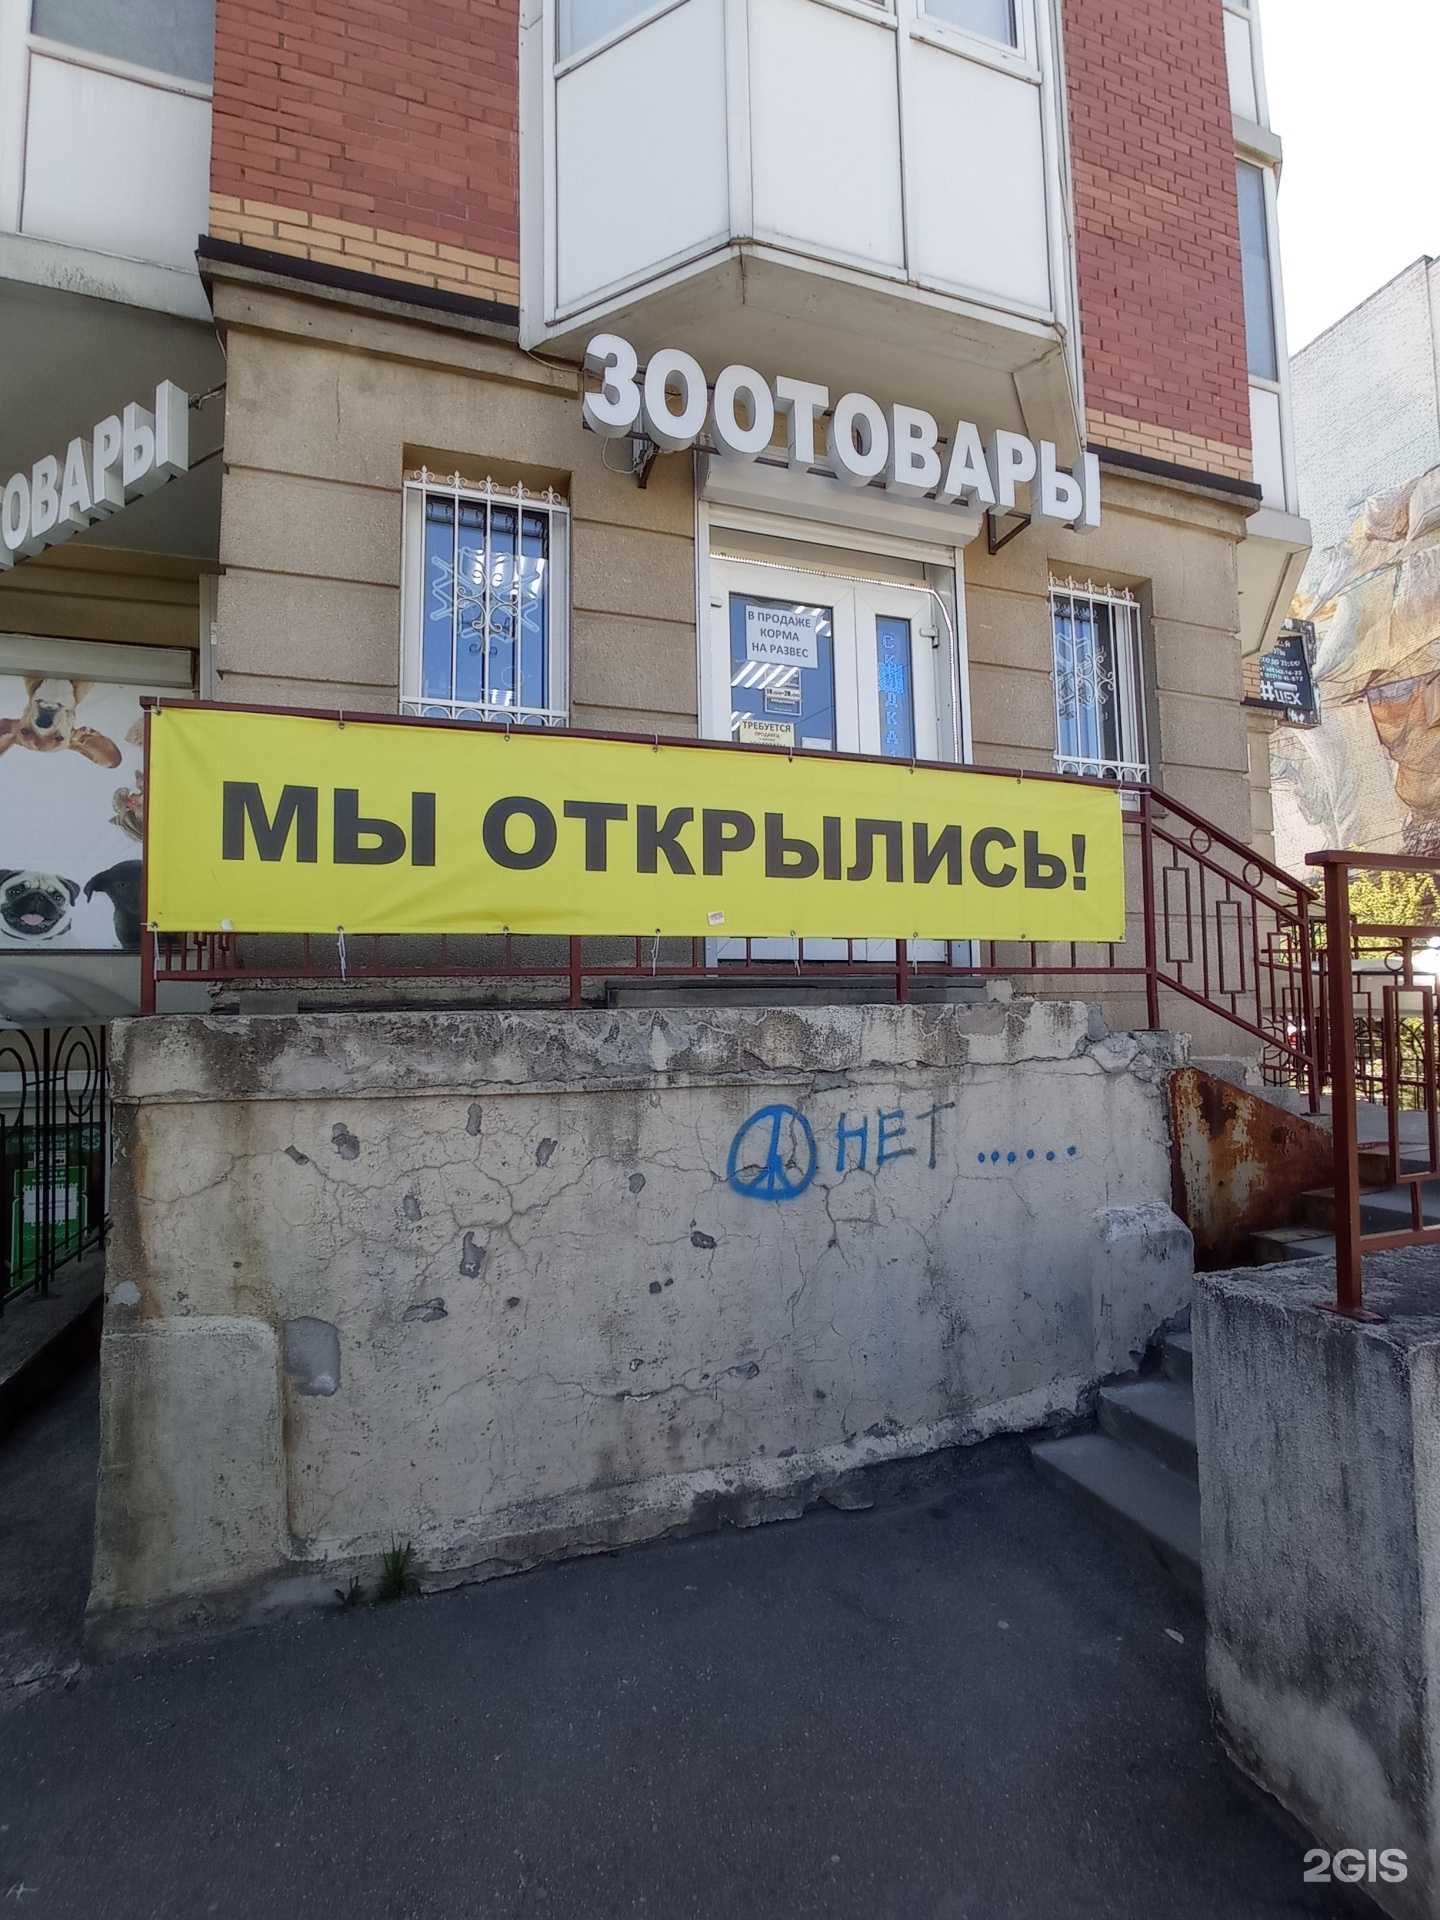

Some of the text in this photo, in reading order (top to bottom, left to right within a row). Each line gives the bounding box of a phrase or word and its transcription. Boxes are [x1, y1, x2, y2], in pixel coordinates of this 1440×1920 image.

[584, 333, 1100, 532] ЗООТОВАРЫ
[0, 379, 188, 560] ОВАРЫ
[748, 610, 811, 628] В ПРОДАЖЕ
[760, 627, 800, 641] КОРМА
[752, 642, 809, 658] НА РАЗВЕС
[742, 720, 792, 733] ТРЕБУЕТСЯ
[222, 781, 1087, 891] МЫ ОТКРЫЛИСЬ!
[835, 1101, 955, 1172] НЕТ
